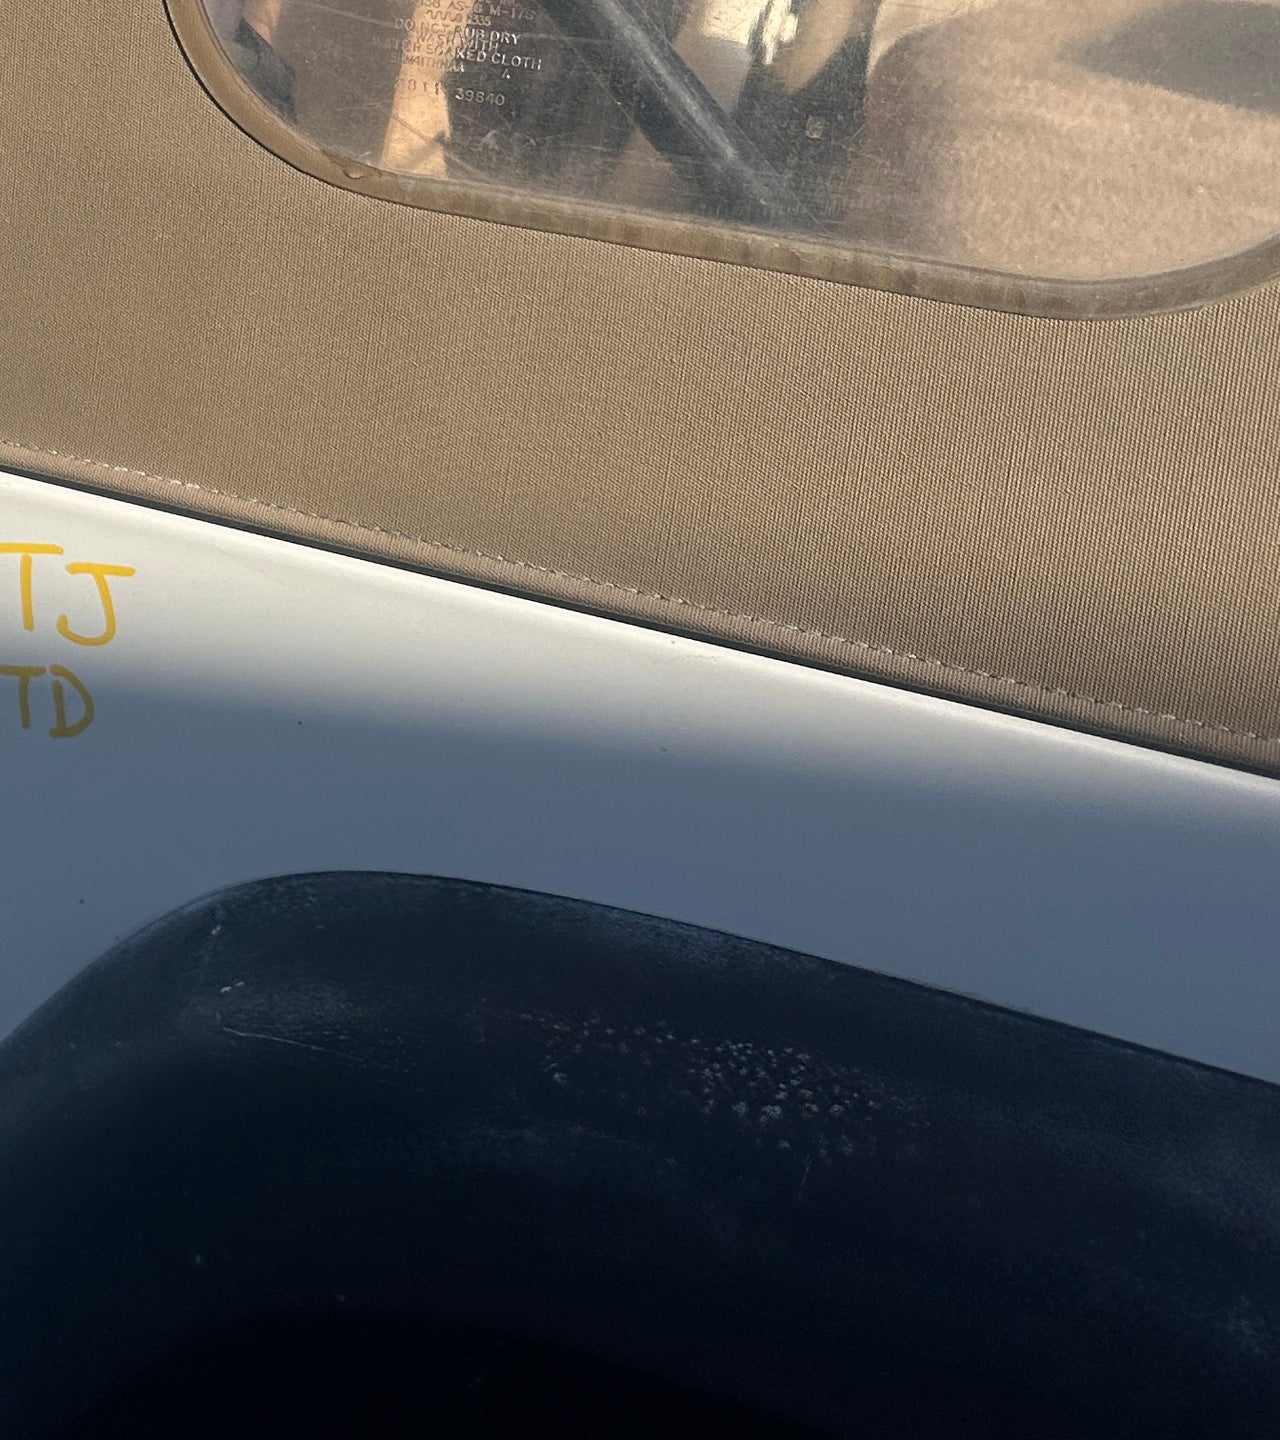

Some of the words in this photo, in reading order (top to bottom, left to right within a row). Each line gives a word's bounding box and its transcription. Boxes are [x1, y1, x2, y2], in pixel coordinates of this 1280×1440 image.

[490, 31, 521, 45] DRY
[427, 43, 486, 61] SOAKED
[492, 53, 542, 70] CLOTH
[455, 88, 505, 106] 39840
